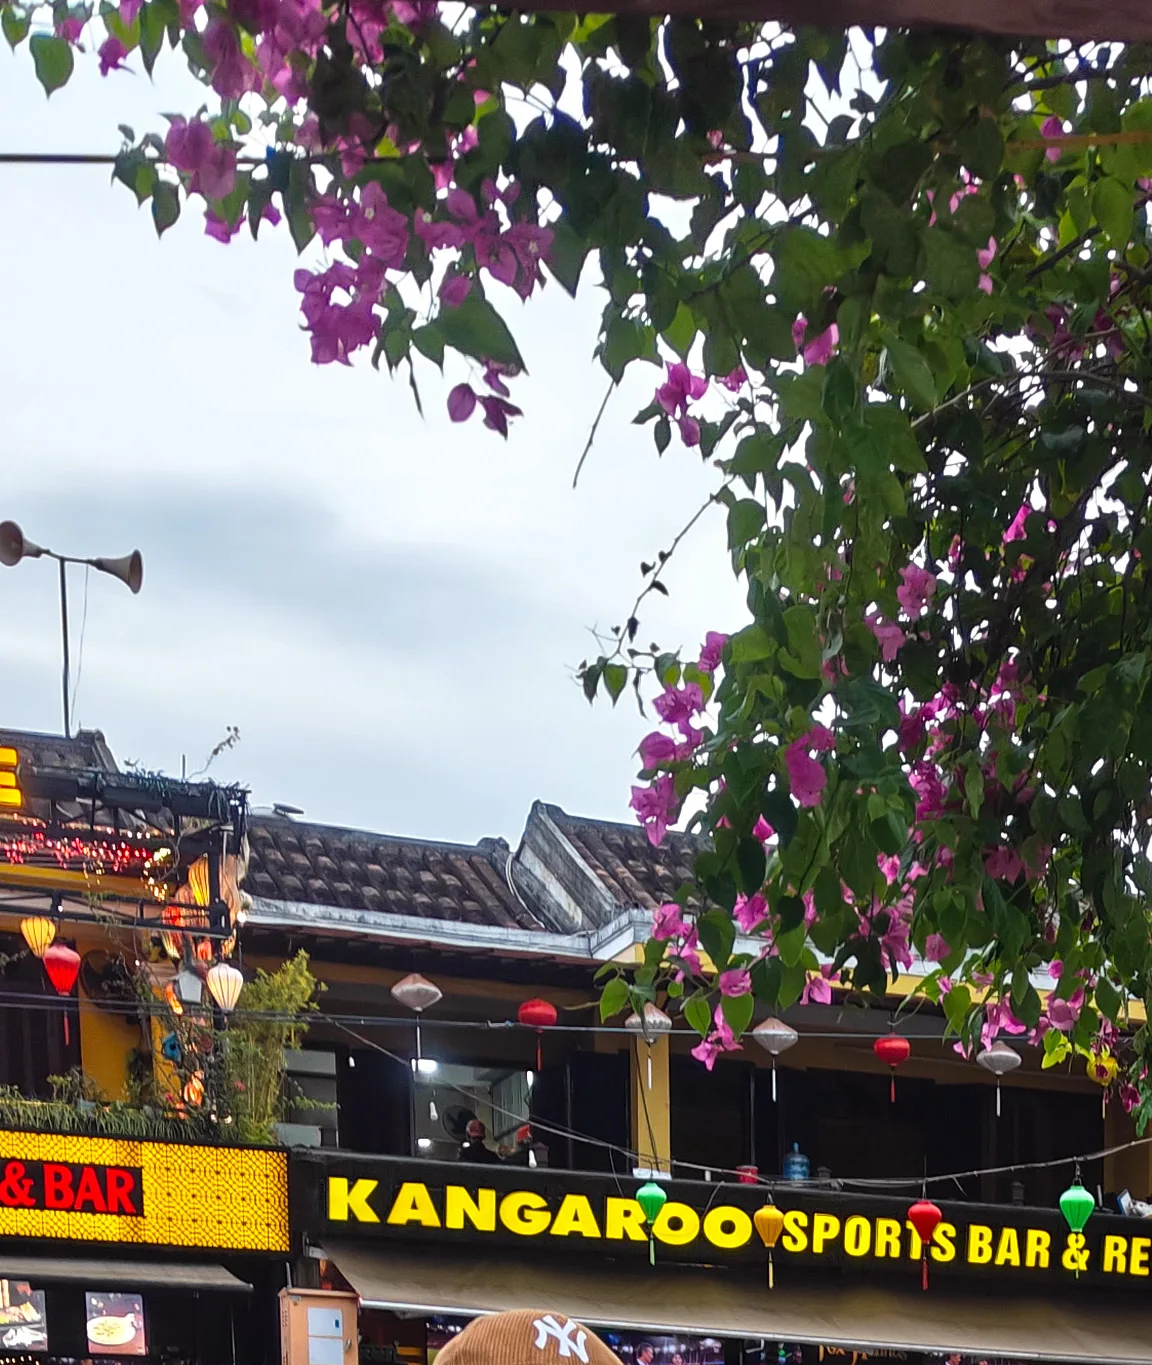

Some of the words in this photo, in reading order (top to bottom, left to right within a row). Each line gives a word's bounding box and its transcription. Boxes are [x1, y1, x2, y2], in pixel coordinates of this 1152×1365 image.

[0, 1160, 36, 1207] &
[43, 1163, 137, 1214] BAR
[328, 1176, 753, 1249] KANGAROO
[781, 1210, 957, 1263] SPORTS
[967, 1223, 1052, 1269] BAR
[1061, 1232, 1091, 1271] &
